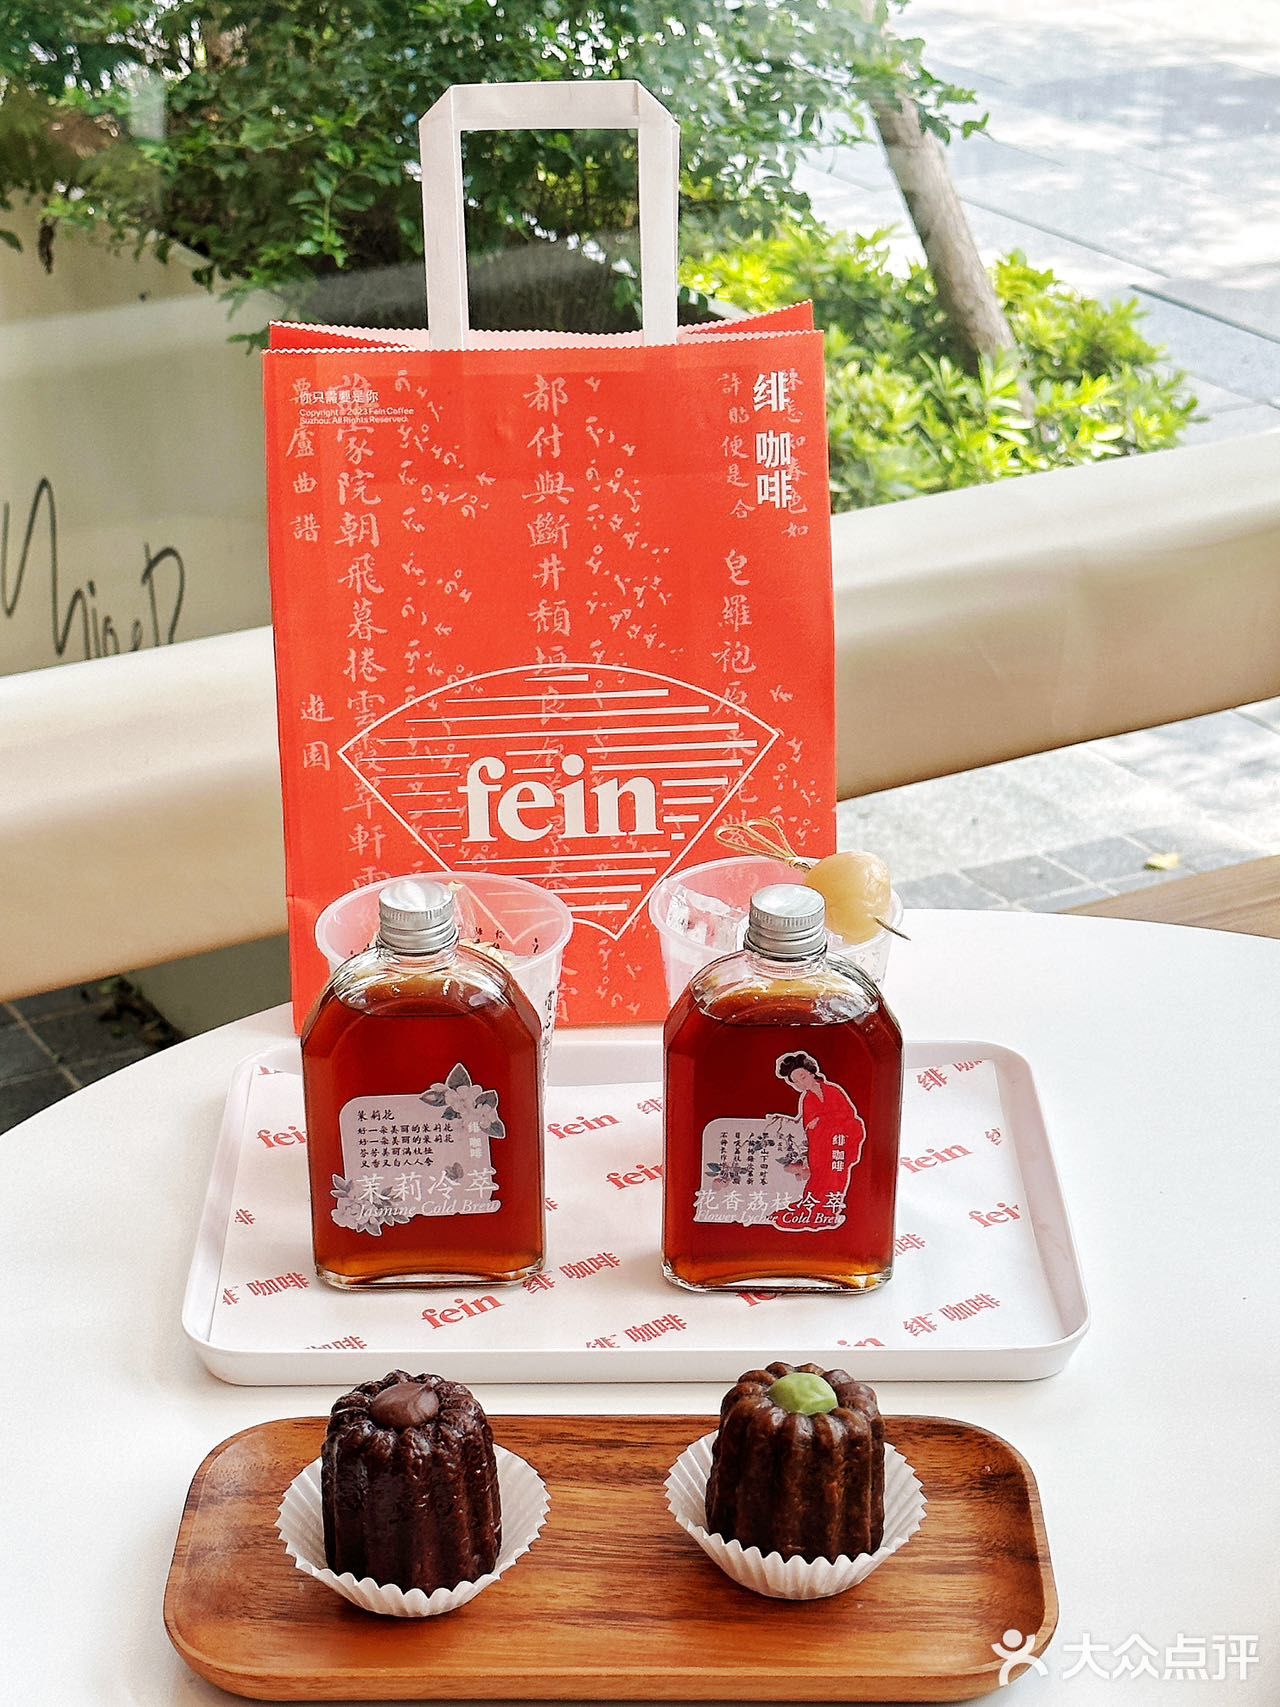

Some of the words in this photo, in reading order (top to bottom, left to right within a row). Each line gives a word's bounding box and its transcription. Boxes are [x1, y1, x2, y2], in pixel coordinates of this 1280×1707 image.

[752, 370, 791, 412] 绯
[347, 407, 368, 416] 2023
[369, 407, 386, 416] Fein
[386, 406, 415, 416] Coffee
[755, 429, 794, 509] 咖啡
[457, 752, 665, 842] fein
[357, 1109, 395, 1121] 茉莉花
[547, 1113, 621, 1140] fein
[256, 1125, 307, 1149] fei
[357, 1123, 454, 1135] 好一朵美丽的茉莉花
[358, 1134, 455, 1146] 好一朵美丽的茉莉花
[832, 1133, 847, 1147] 绯
[831, 1149, 845, 1172] 咖啡
[899, 1144, 974, 1174] fein
[355, 1168, 498, 1204] 茉莉冷萃
[357, 1203, 417, 1220] Jasmine
[421, 1199, 457, 1214] Cold
[462, 1198, 501, 1213] Brew
[694, 1190, 847, 1215] 花香荔枝冷萃
[968, 1202, 1021, 1228] fei
[783, 1211, 811, 1224] Cold
[814, 1212, 845, 1224] Brew
[246, 1271, 311, 1297] 咖啡
[522, 1270, 556, 1294] 绯
[558, 1250, 622, 1280] 咖啡
[420, 1295, 505, 1330] fein
[902, 1312, 938, 1338] 绯
[939, 1293, 1002, 1322] 咖啡
[622, 1312, 688, 1343] 咖啡
